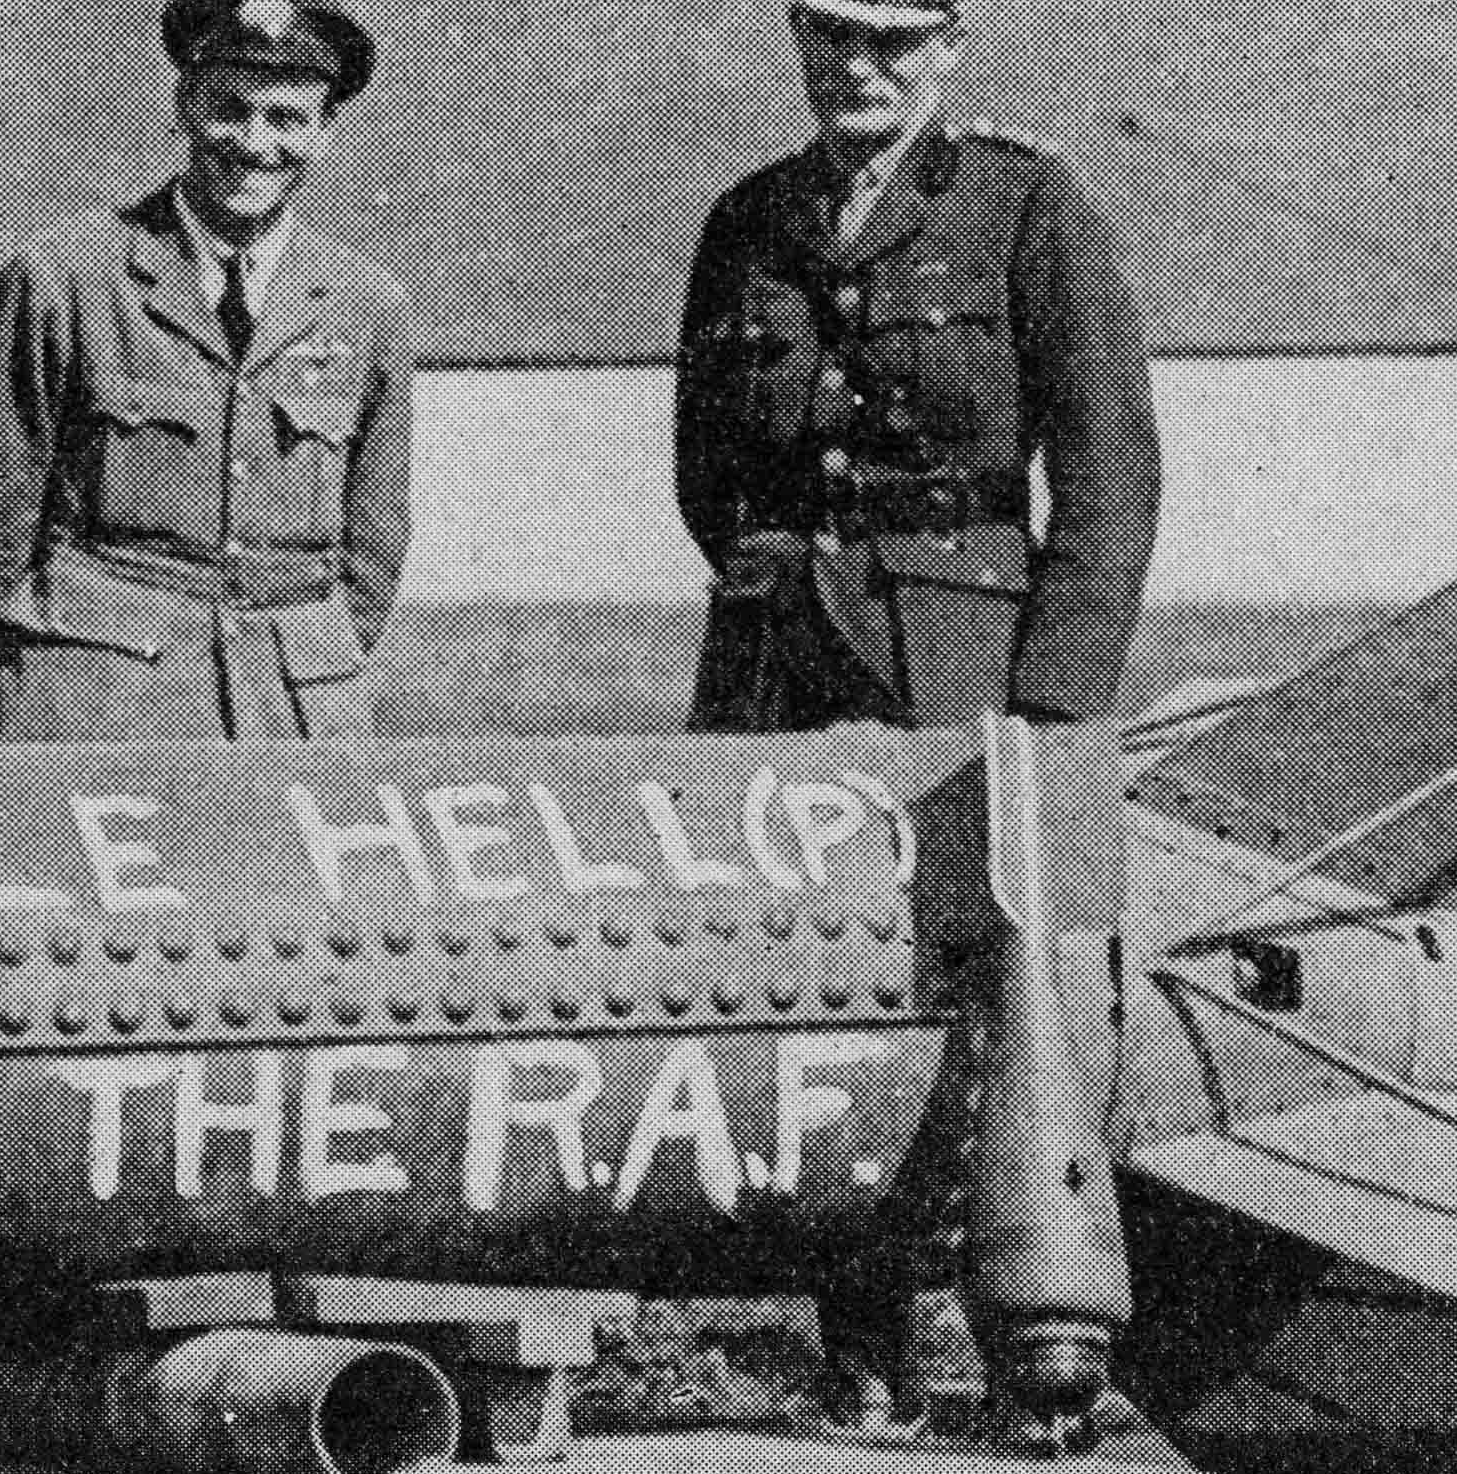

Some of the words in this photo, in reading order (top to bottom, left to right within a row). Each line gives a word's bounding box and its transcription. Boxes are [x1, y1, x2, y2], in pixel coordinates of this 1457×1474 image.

[286, 768, 918, 909] HELL(P)
[55, 1040, 414, 1204] THE
[463, 1034, 888, 1212] R.A.F.
